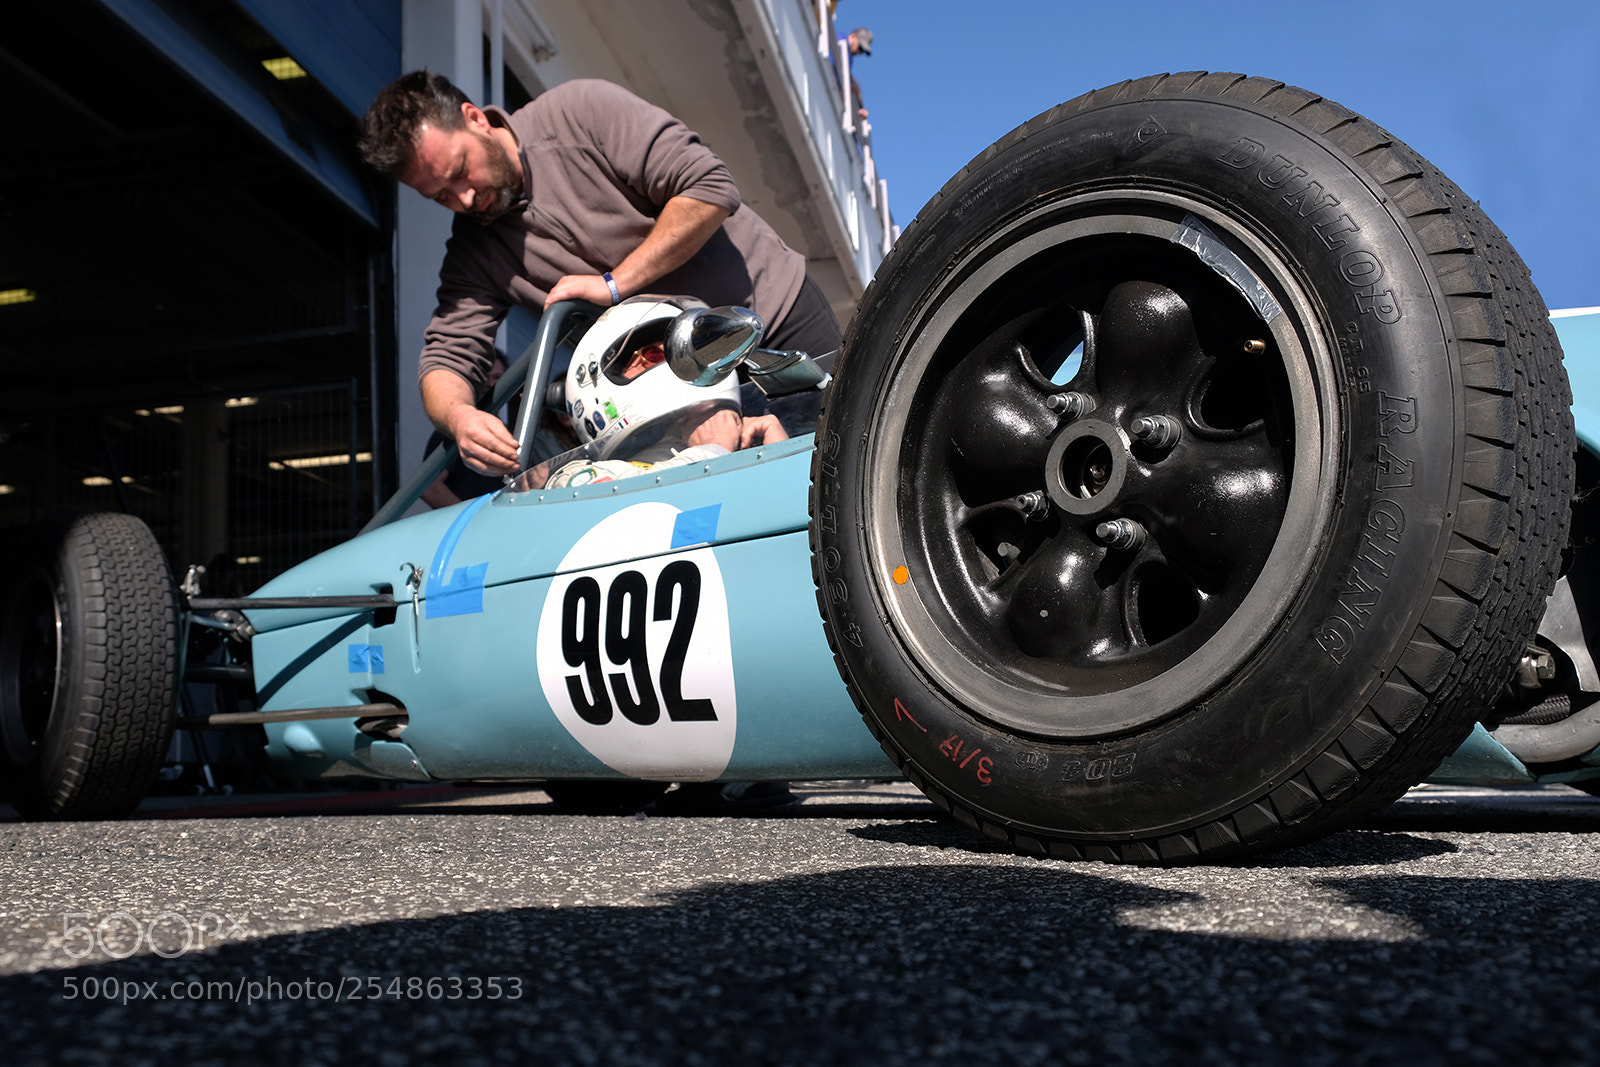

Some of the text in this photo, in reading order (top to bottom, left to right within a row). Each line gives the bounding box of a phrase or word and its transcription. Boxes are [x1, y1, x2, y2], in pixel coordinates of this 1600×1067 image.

[1216, 137, 1402, 325] DUNLOP
[1314, 391, 1418, 665] RACING
[561, 560, 718, 726] 992
